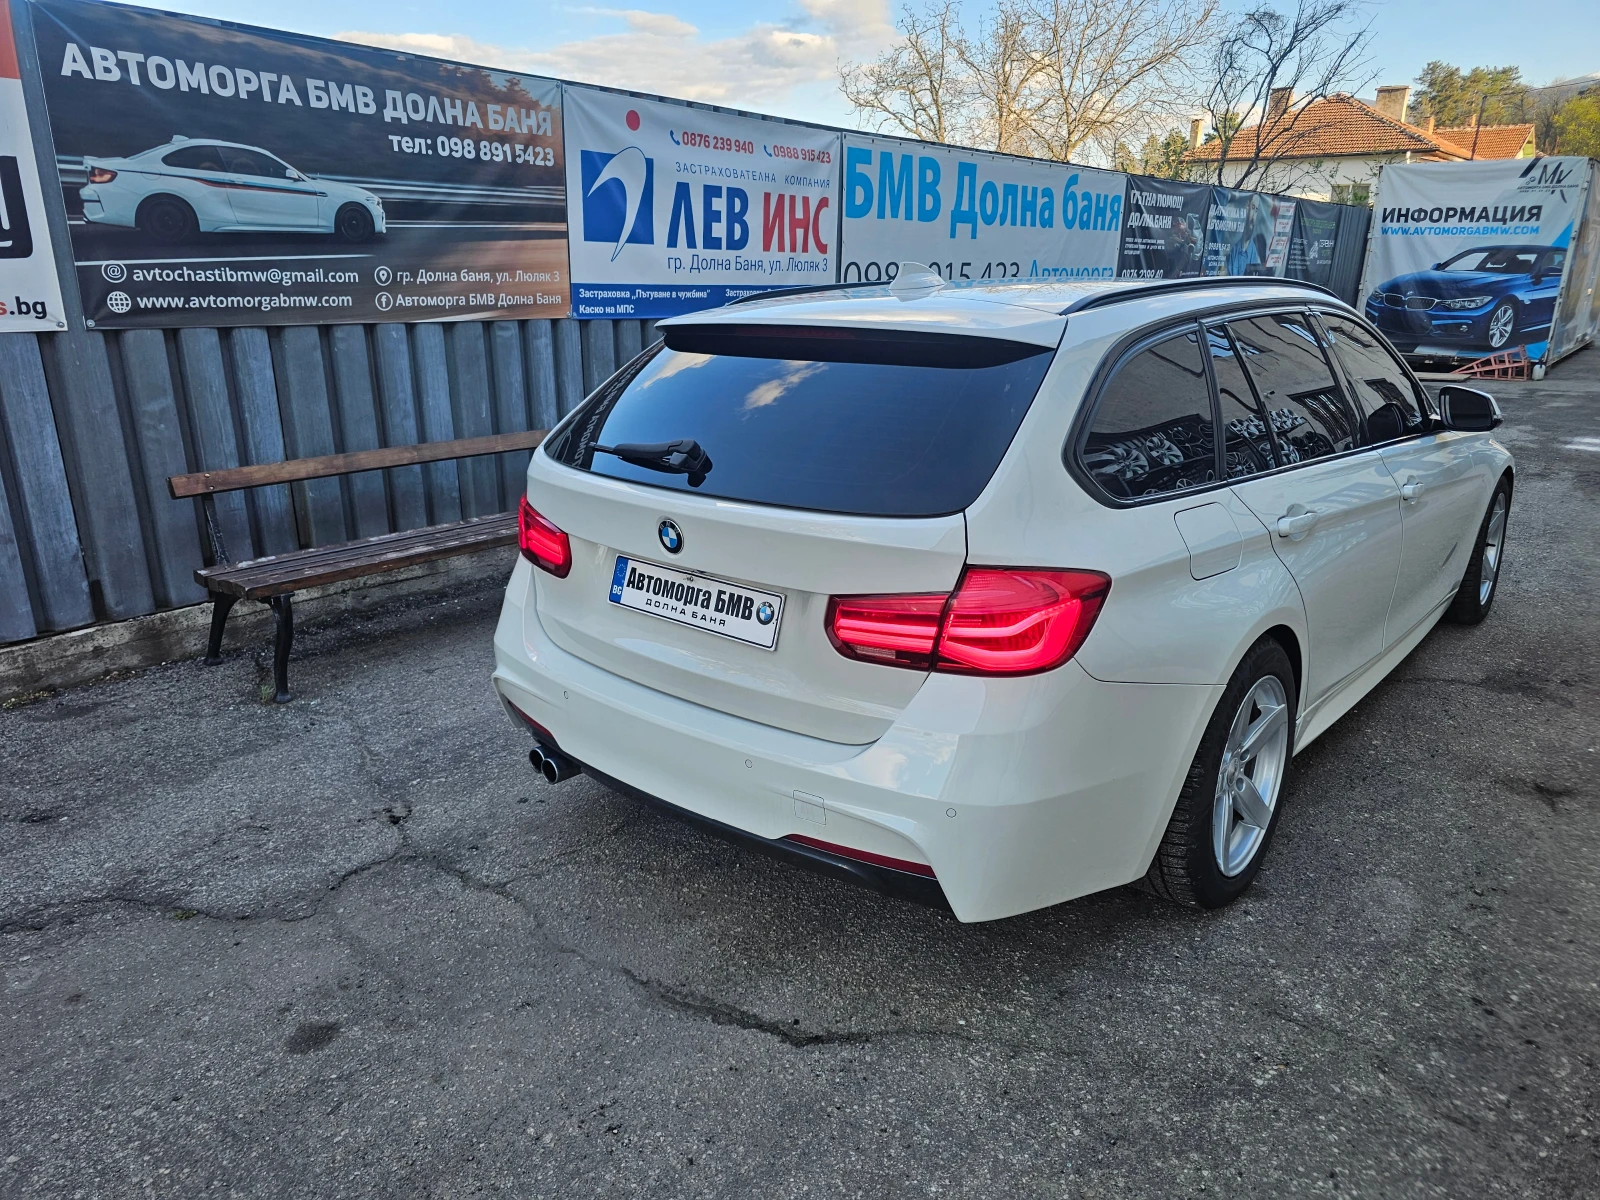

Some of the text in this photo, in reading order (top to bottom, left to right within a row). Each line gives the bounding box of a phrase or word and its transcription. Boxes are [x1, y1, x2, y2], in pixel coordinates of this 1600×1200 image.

[61, 43, 552, 136] АВТОМОРГА БМВ ДОЛНА БАНЯ
[389, 135, 555, 167] тел: 098 891 5423
[682, 131, 754, 154] 0876 239 940
[773, 145, 831, 164] 0988 915 423
[675, 162, 830, 189] ЗАСТРАХОВАТЕЛНА КОМПАНИЯ
[845, 146, 1122, 239] БМВ Долна баня
[666, 181, 829, 254] ЛЕВ ИНС
[1382, 205, 1543, 225] ИНФОРМАЦИЯ
[1381, 226, 1540, 236] WWW.AVTOMORGABMW.COM
[668, 254, 828, 275] гр. Долна Баня, ул. Люляк 3
[133, 267, 359, 285] avtochastibmw@gmail.com
[397, 269, 560, 285] гр. Долна баня, ул. Люляк 3
[137, 294, 352, 310] www.avtomorgabmw.com
[396, 293, 562, 308] Автоморга БМВ Долна Баня
[579, 288, 630, 299] Застраховка
[579, 305, 635, 314] Каско на МПС
[612, 585, 622, 595] BG
[626, 566, 755, 620] Автоморга БМВ
[646, 598, 726, 626] ДОЛНА БАНЯ
